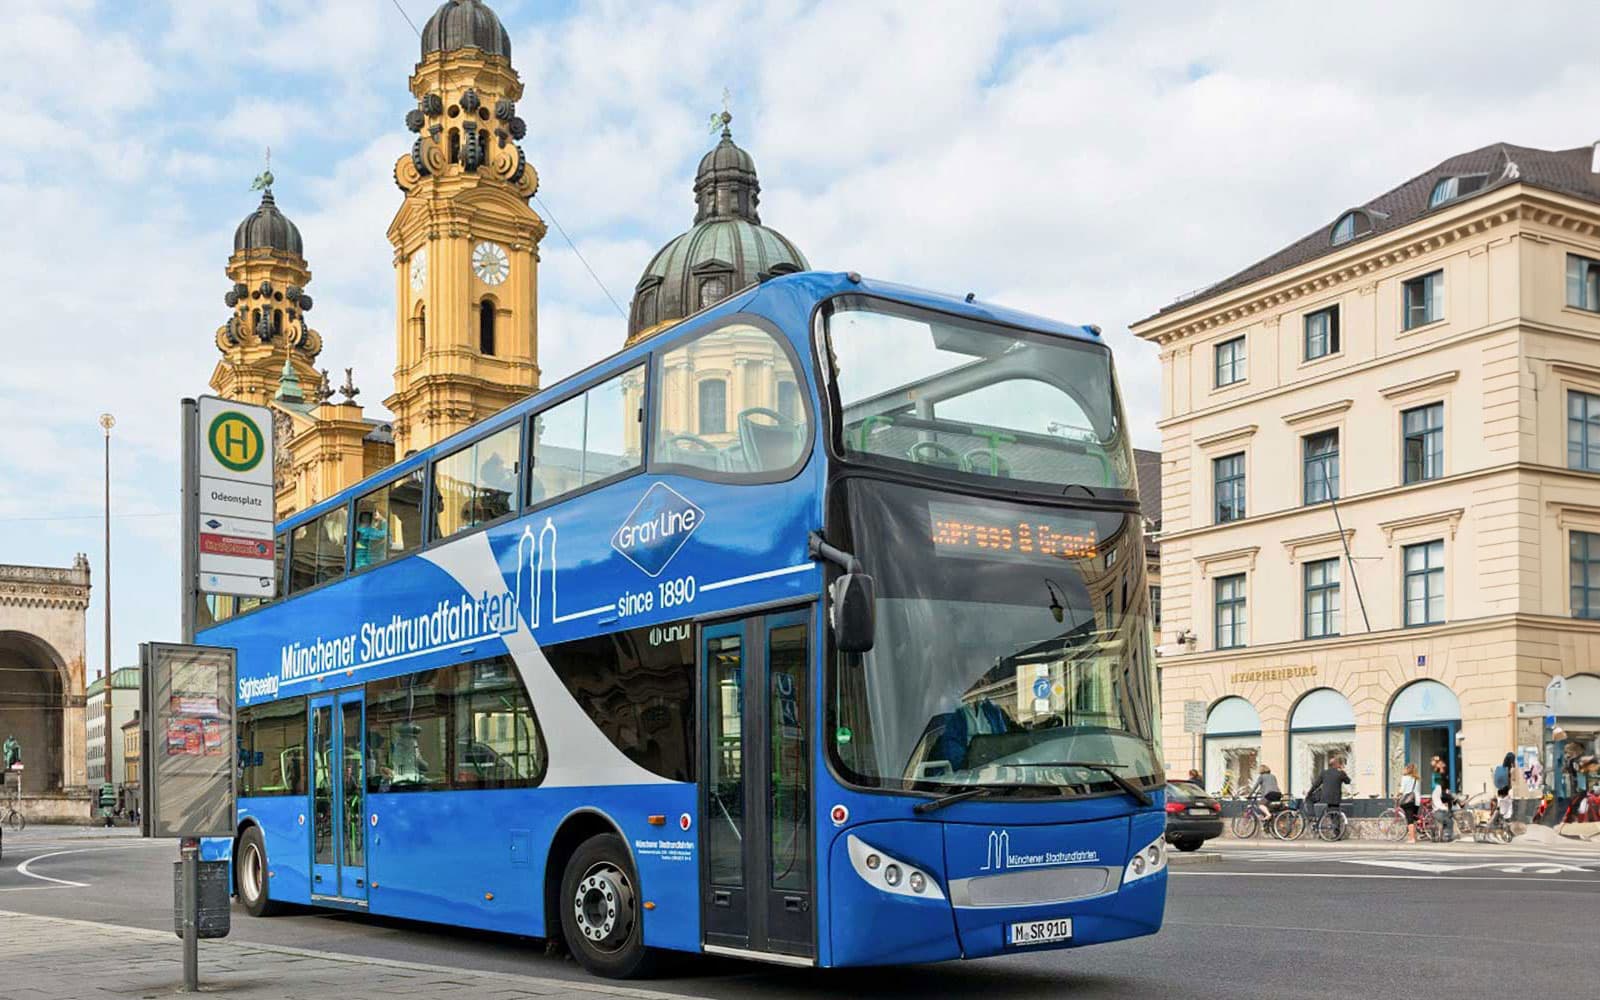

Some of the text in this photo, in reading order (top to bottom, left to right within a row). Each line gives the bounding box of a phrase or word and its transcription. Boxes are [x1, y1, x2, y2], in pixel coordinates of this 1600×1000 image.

[225, 424, 248, 459] H
[211, 491, 262, 506] Odeonsplatz
[1038, 525, 1096, 558] Grand
[618, 575, 696, 617] since 1890
[281, 590, 516, 680] Münchener Stadtrundfahrten
[239, 672, 279, 703] Sightseeing
[1231, 665, 1317, 683] NYMPHENBURG
[1009, 850, 1097, 864] Münchener Stadtrundfahrten
[1031, 923, 1045, 939] SR
[1047, 921, 1067, 937] 910
